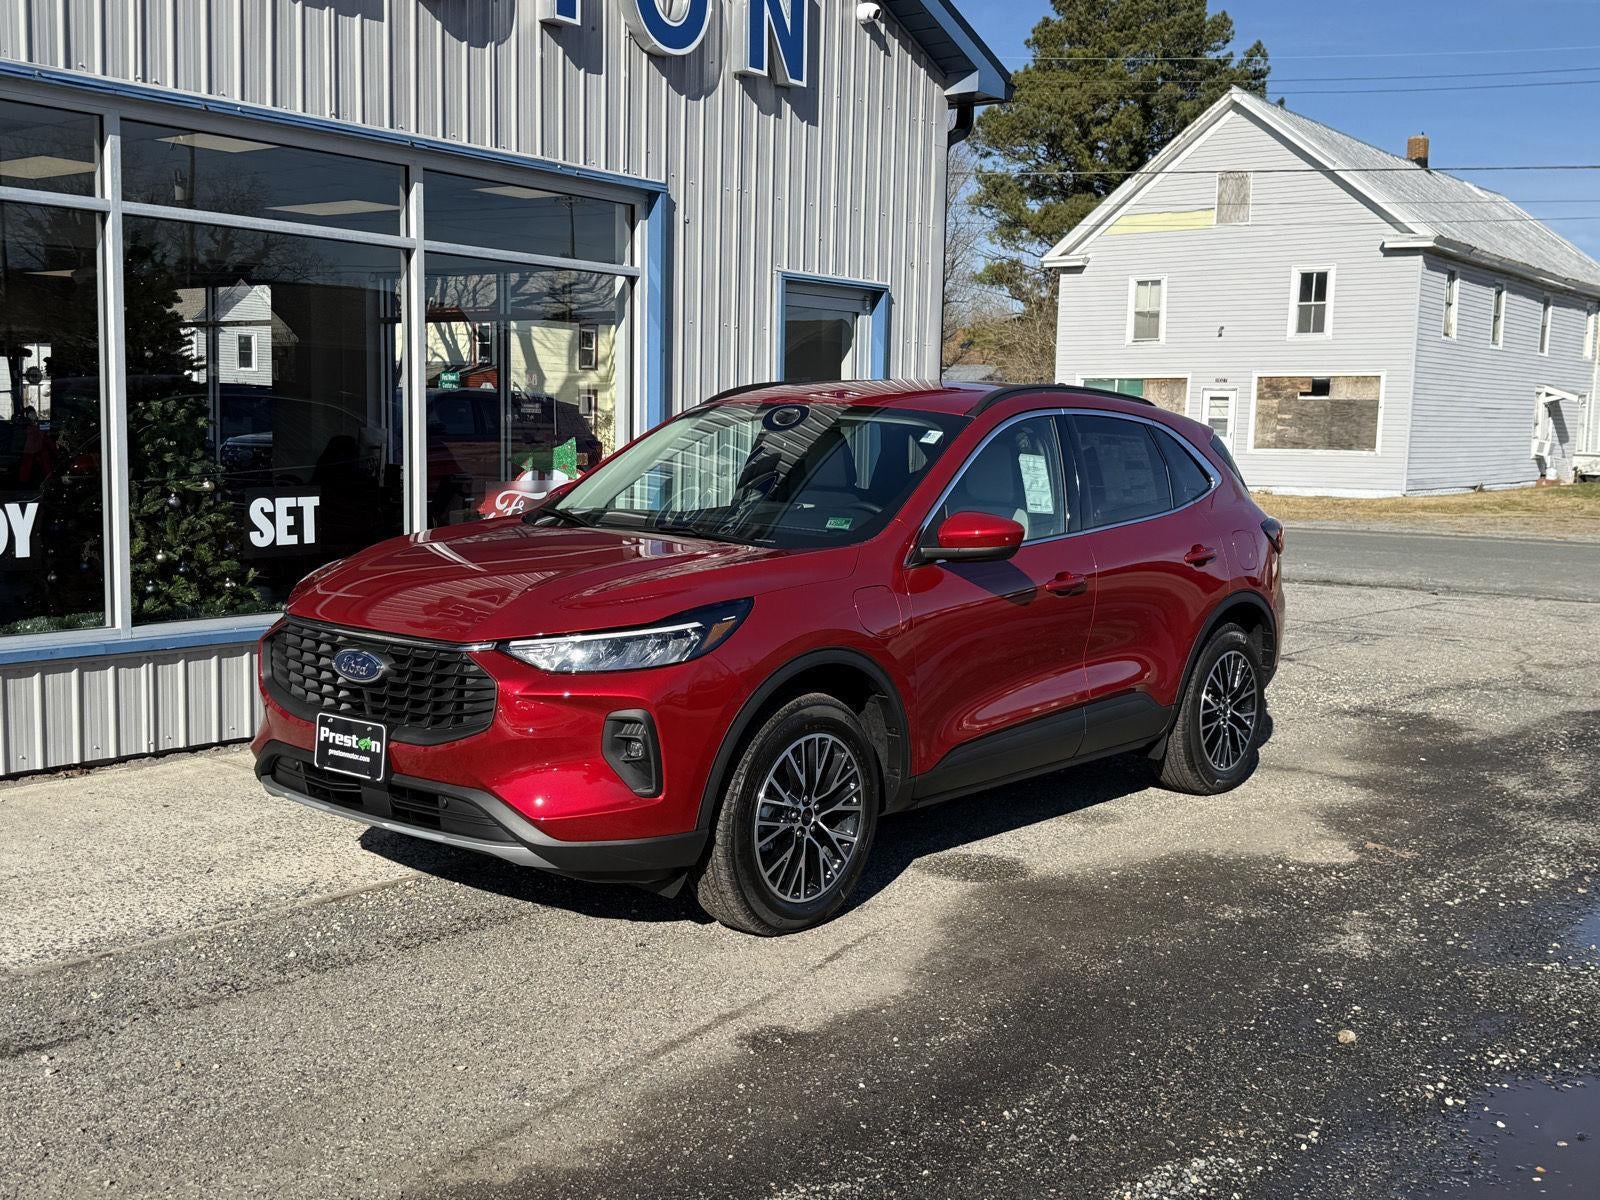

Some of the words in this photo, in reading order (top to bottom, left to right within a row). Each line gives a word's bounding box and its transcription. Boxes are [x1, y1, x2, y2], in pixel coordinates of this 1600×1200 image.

[540, 0, 807, 88] ON
[249, 496, 320, 548] SET
[341, 654, 370, 676] Ford
[319, 726, 381, 754] Preston
[328, 748, 370, 763] prestonmotor.com
